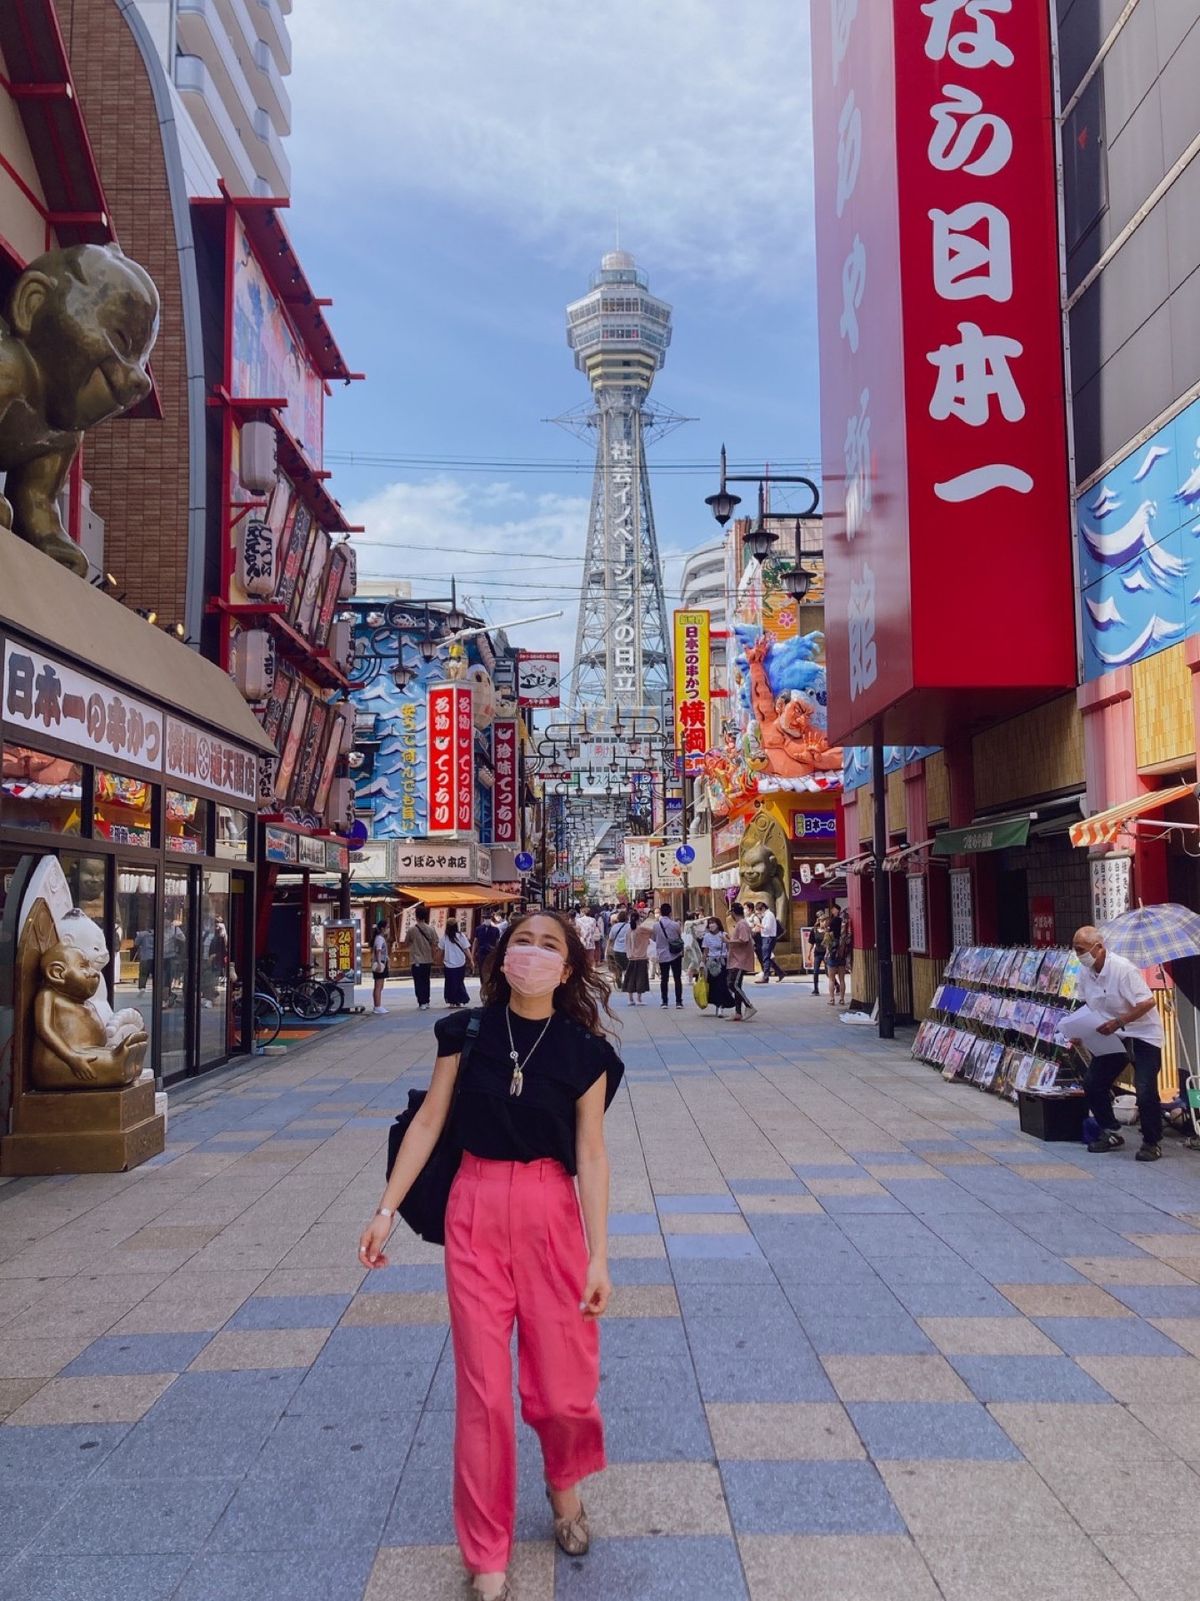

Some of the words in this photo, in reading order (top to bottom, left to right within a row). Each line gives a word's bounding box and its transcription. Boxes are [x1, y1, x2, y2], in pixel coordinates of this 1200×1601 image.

[685, 626, 699, 699] 日本一の串かつ
[7, 652, 160, 762] 日本一の串かつ
[434, 696, 450, 730] 名物
[459, 697, 471, 730] 名物
[679, 700, 706, 754] 横綱
[434, 754, 450, 824] てっちり
[458, 754, 471, 824] てっちり
[496, 743, 512, 839] 珍味てっちり
[805, 818, 836, 832] 日本一の
[401, 854, 467, 868] づぼらや本店
[338, 931, 351, 970] 24時間
